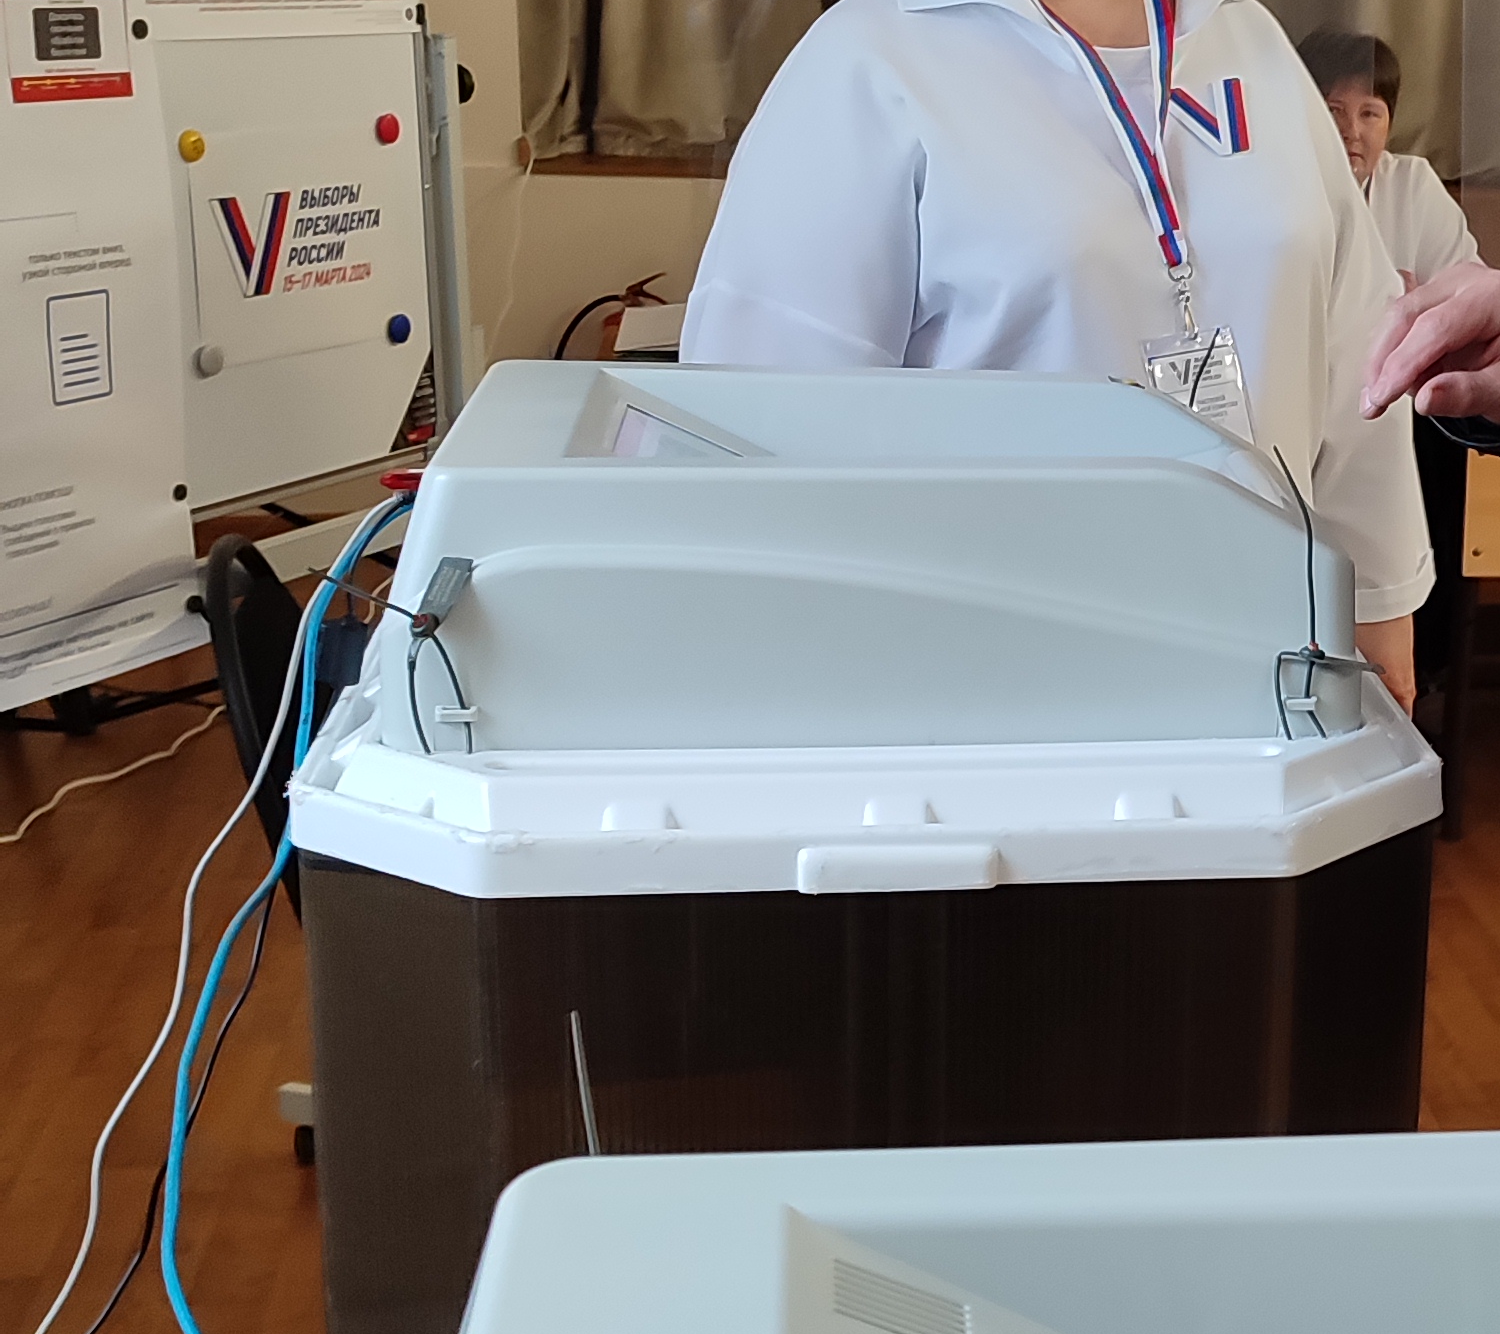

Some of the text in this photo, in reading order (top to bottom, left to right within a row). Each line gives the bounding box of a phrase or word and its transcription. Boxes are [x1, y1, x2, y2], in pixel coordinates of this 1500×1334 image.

[299, 183, 361, 210] ВЫБОРЫ
[292, 208, 381, 239] ПРЕЗИДЕНТА
[287, 240, 346, 267] РОССИИ
[314, 268, 347, 288] МАРТА
